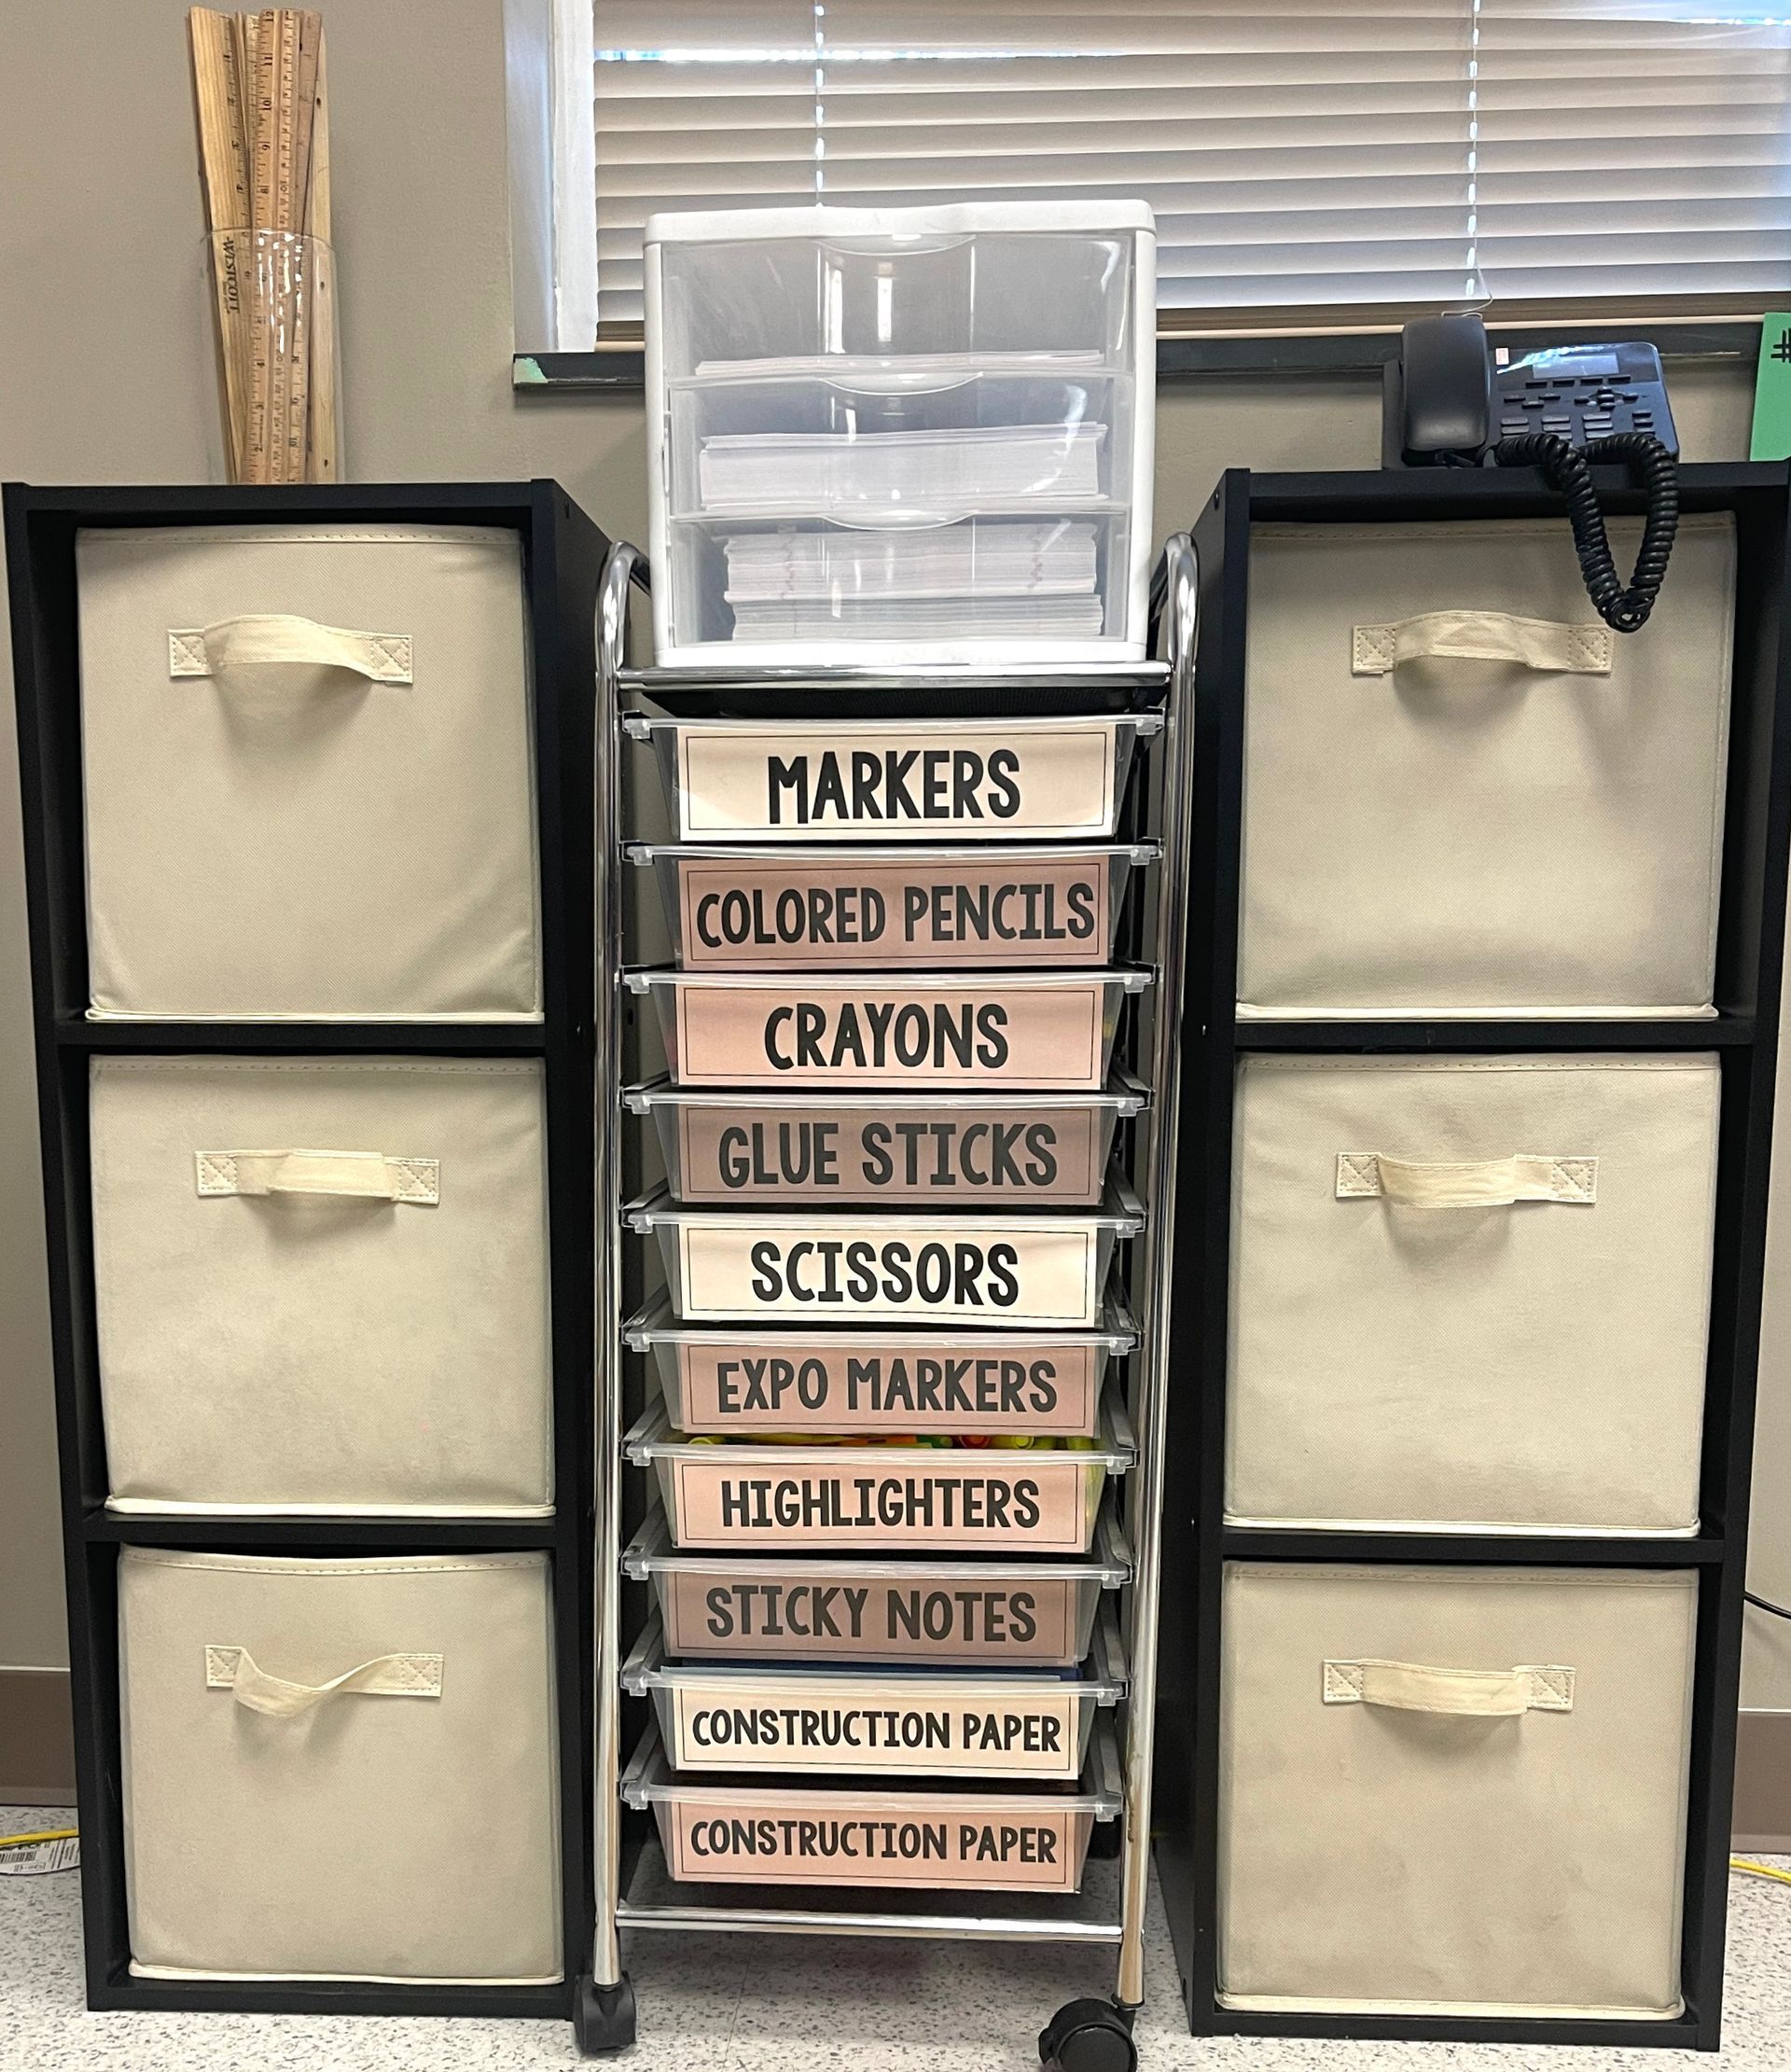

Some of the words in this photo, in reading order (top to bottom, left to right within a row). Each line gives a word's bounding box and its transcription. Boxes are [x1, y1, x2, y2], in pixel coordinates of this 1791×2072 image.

[263, 99, 271, 111] 10
[768, 749, 1020, 824] MARKERS
[697, 887, 885, 948] COLORED
[905, 883, 1094, 941] PENCILS
[765, 1003, 1008, 1070] CRAYONS
[719, 1123, 839, 1188] GLUE
[862, 1122, 1057, 1186] STICKS
[751, 1242, 1019, 1306] SCISSORS
[717, 1358, 827, 1412] EXPO
[848, 1358, 1057, 1412] MARKERS
[722, 1479, 1039, 1528] HIGHLIGHTERS
[707, 1585, 868, 1637] STICKY
[888, 1590, 1036, 1642] NOTES
[693, 1709, 950, 1748] CONSTRUCTION
[964, 1714, 1061, 1752] PAPER
[691, 1820, 947, 1859] CONSTRUCTION
[960, 1825, 1056, 1863] PAPER
